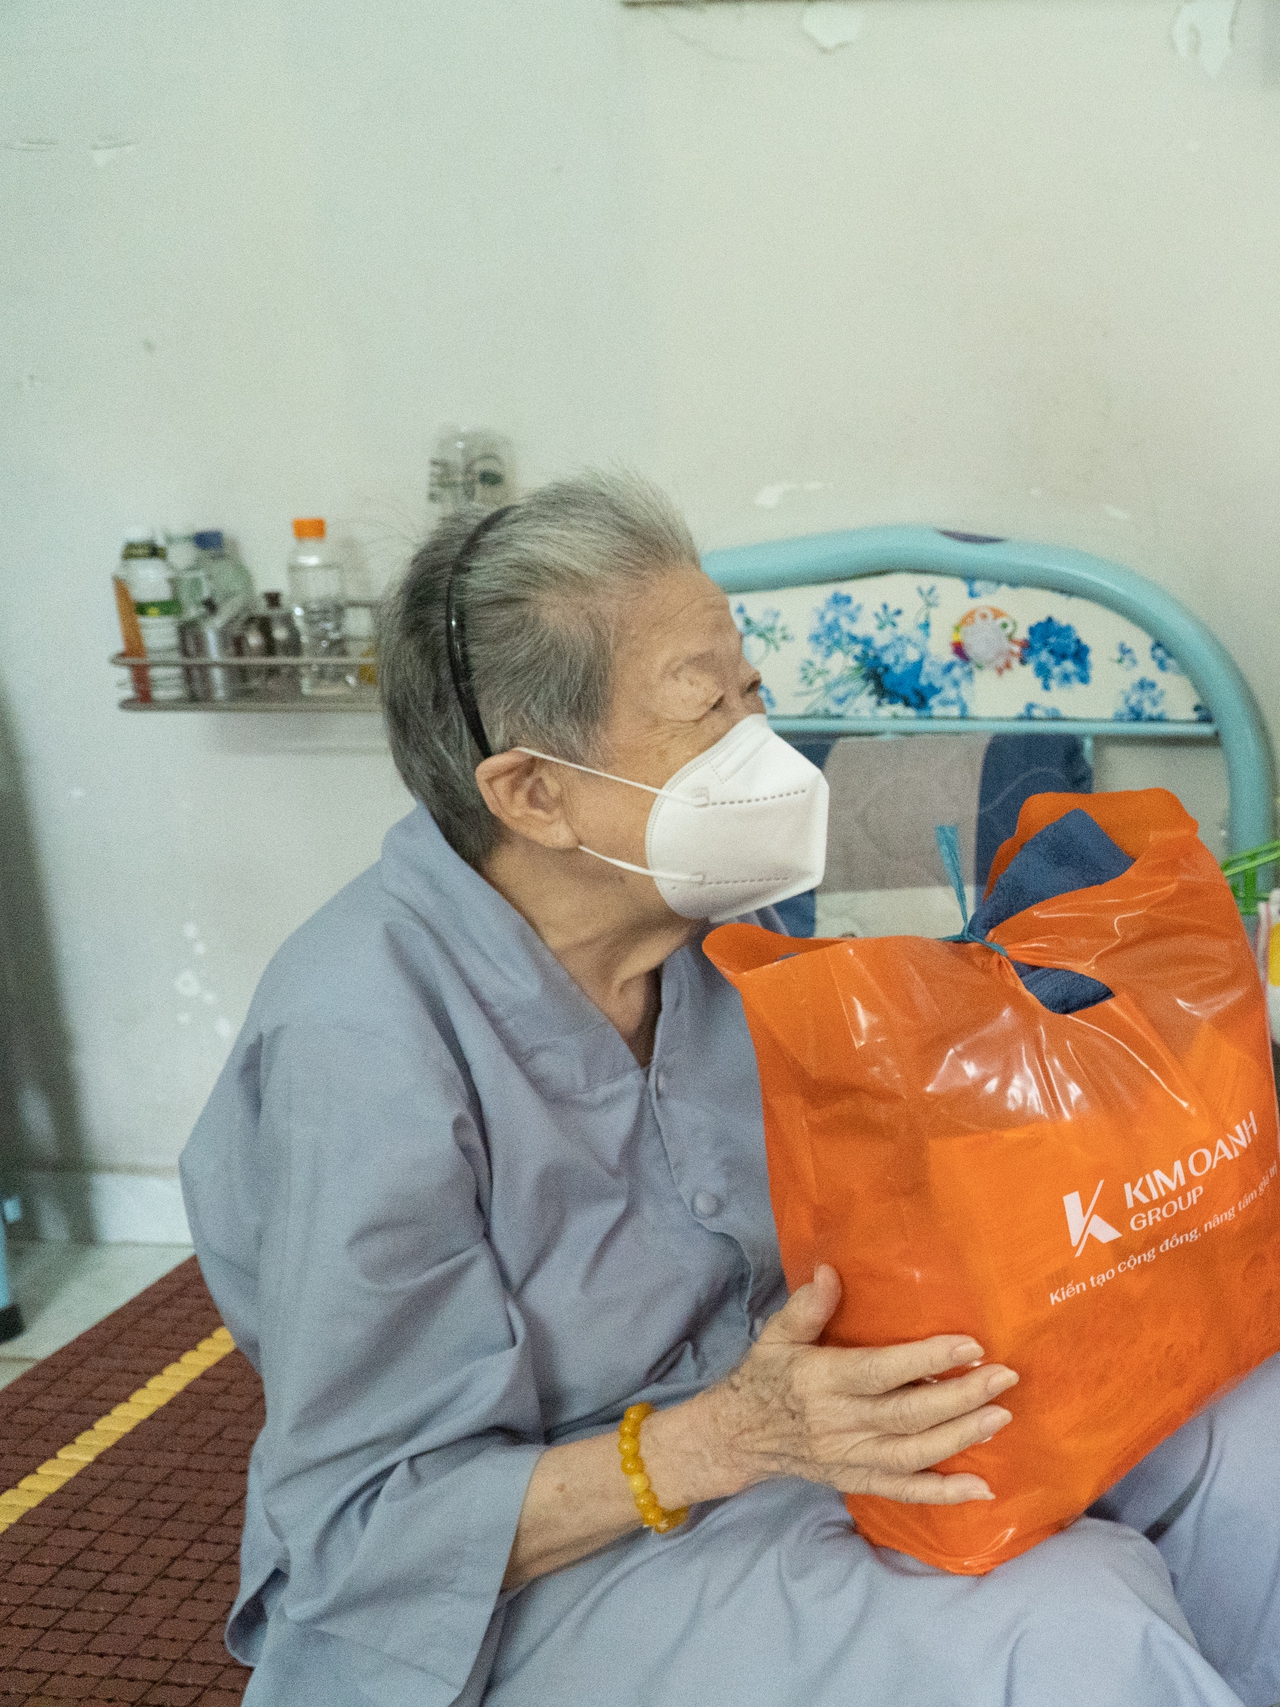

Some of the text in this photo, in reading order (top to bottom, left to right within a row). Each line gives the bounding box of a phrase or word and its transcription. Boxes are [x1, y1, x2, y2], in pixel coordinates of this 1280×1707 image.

[1123, 1110, 1259, 1210] KIM OANH
[1129, 1185, 1204, 1232] GROUP
[1049, 1279, 1087, 1306] Kiến
[1089, 1268, 1116, 1288] tạo
[1117, 1246, 1157, 1274] cộng
[1203, 1205, 1236, 1233] nâng
